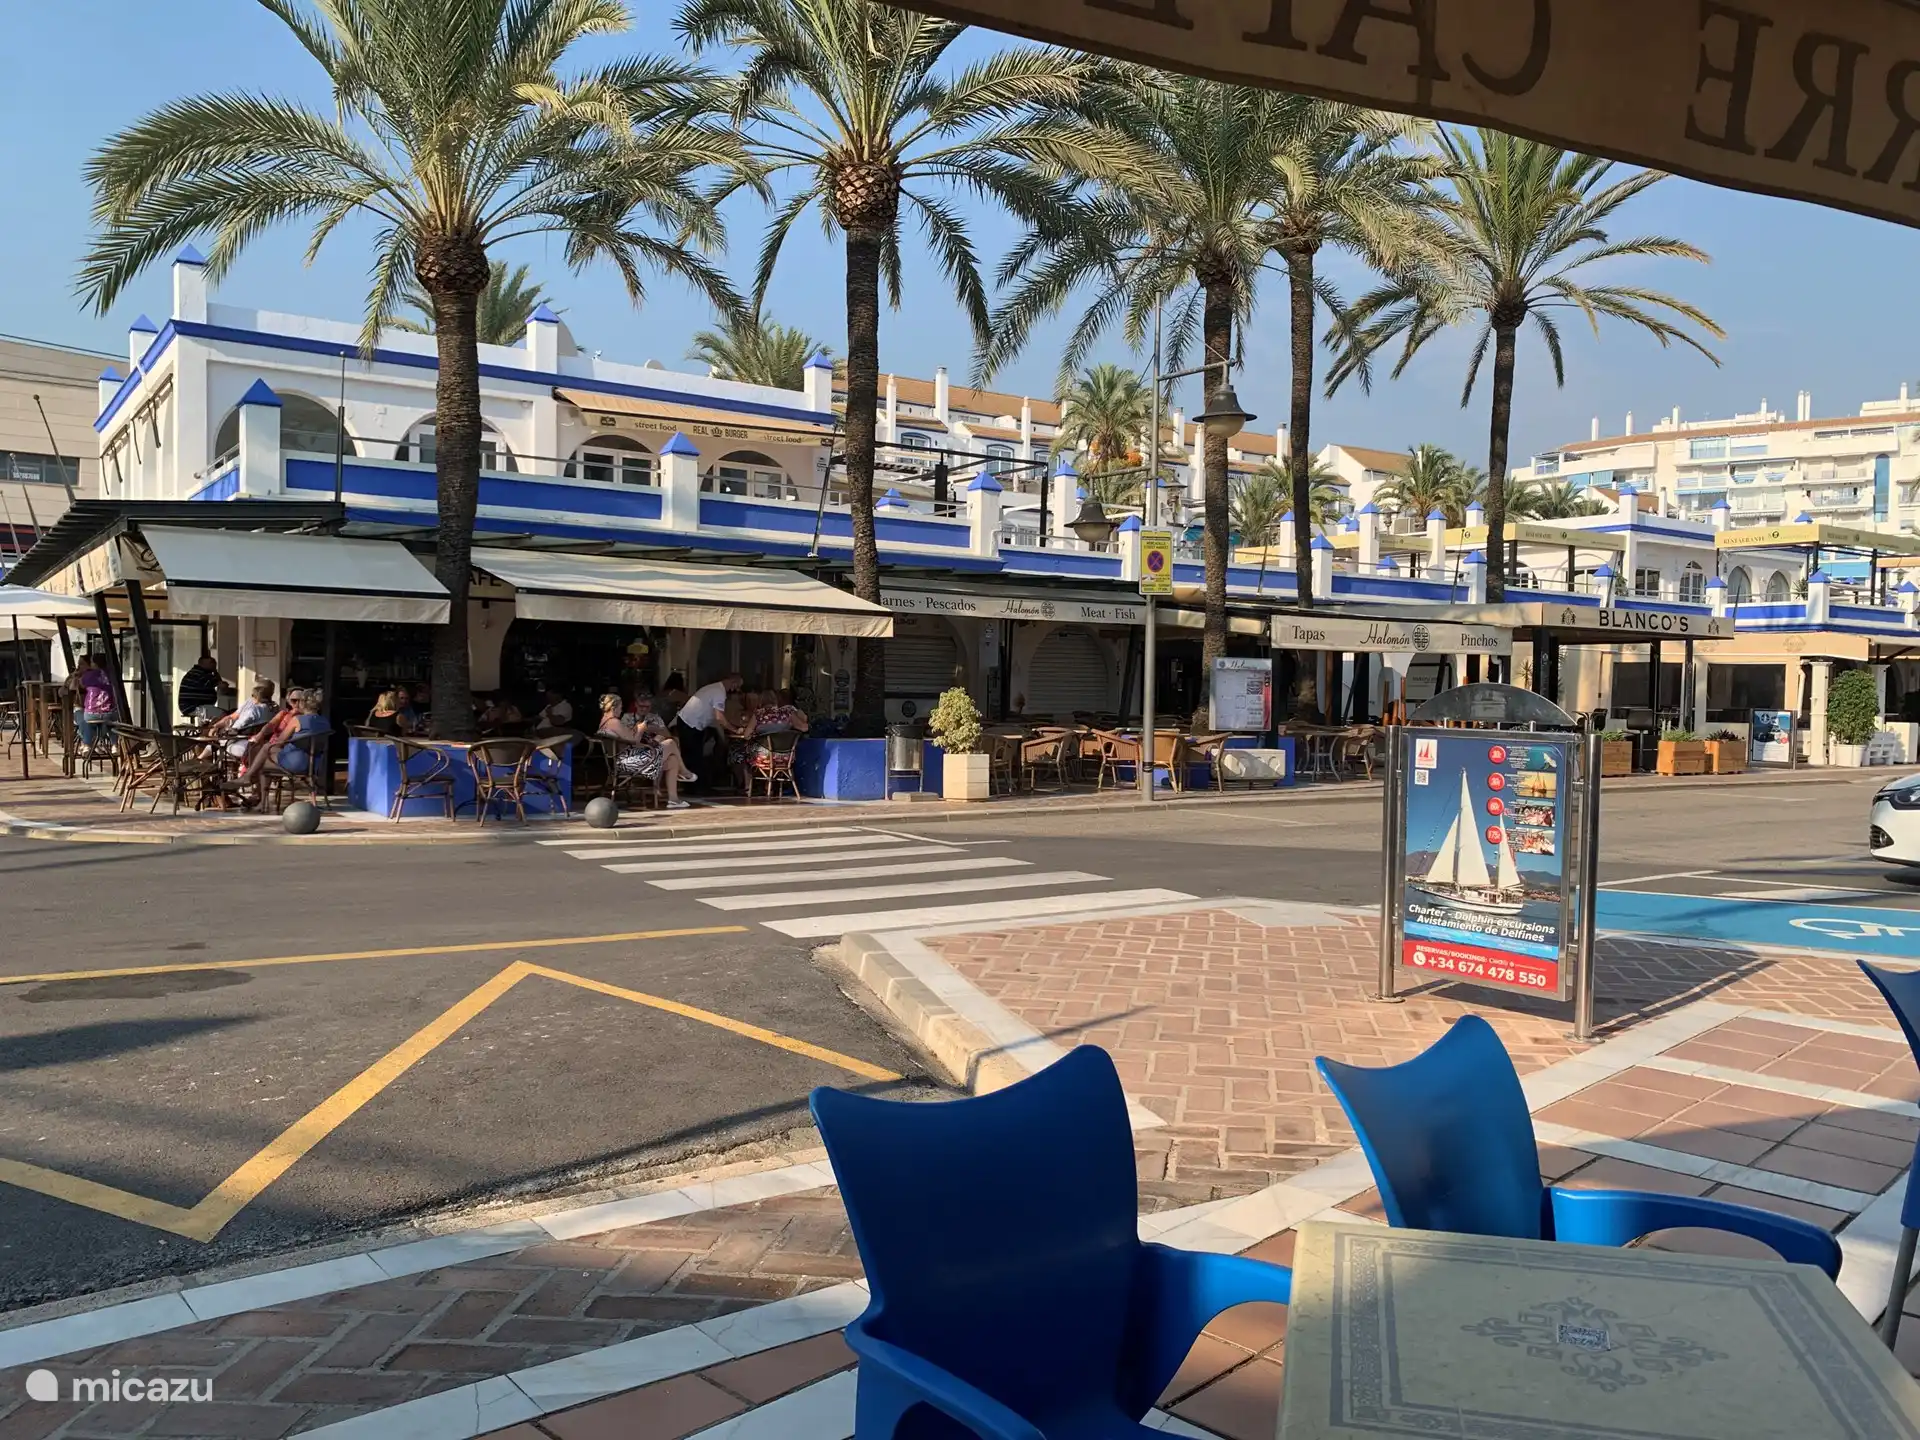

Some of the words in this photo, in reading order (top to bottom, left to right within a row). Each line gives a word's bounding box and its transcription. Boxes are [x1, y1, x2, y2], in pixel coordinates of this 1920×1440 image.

[634, 420, 657, 431] street
[659, 422, 677, 432] food
[692, 425, 709, 436] REAL
[725, 429, 748, 439] BURGER
[785, 436, 802, 445] food
[880, 596, 915, 609] arnes
[926, 597, 976, 612] Pescados
[1000, 600, 1040, 615] Halomón
[1081, 606, 1106, 619] Meat
[1115, 608, 1136, 620] Fish
[1599, 610, 1689, 632] BLANCO'S
[1292, 625, 1326, 641] Tapas
[1360, 623, 1410, 645] Halomón
[1460, 633, 1498, 648] Pinchos
[1408, 904, 1446, 917] Charter
[1496, 917, 1555, 934] excursions
[1416, 915, 1483, 933] Avistamiento
[1485, 925, 1499, 935] de
[1501, 927, 1545, 942] Delfines
[1428, 957, 1455, 970] +34
[1458, 961, 1484, 975] 674
[1488, 967, 1515, 981] 478
[1519, 972, 1547, 987] 550
